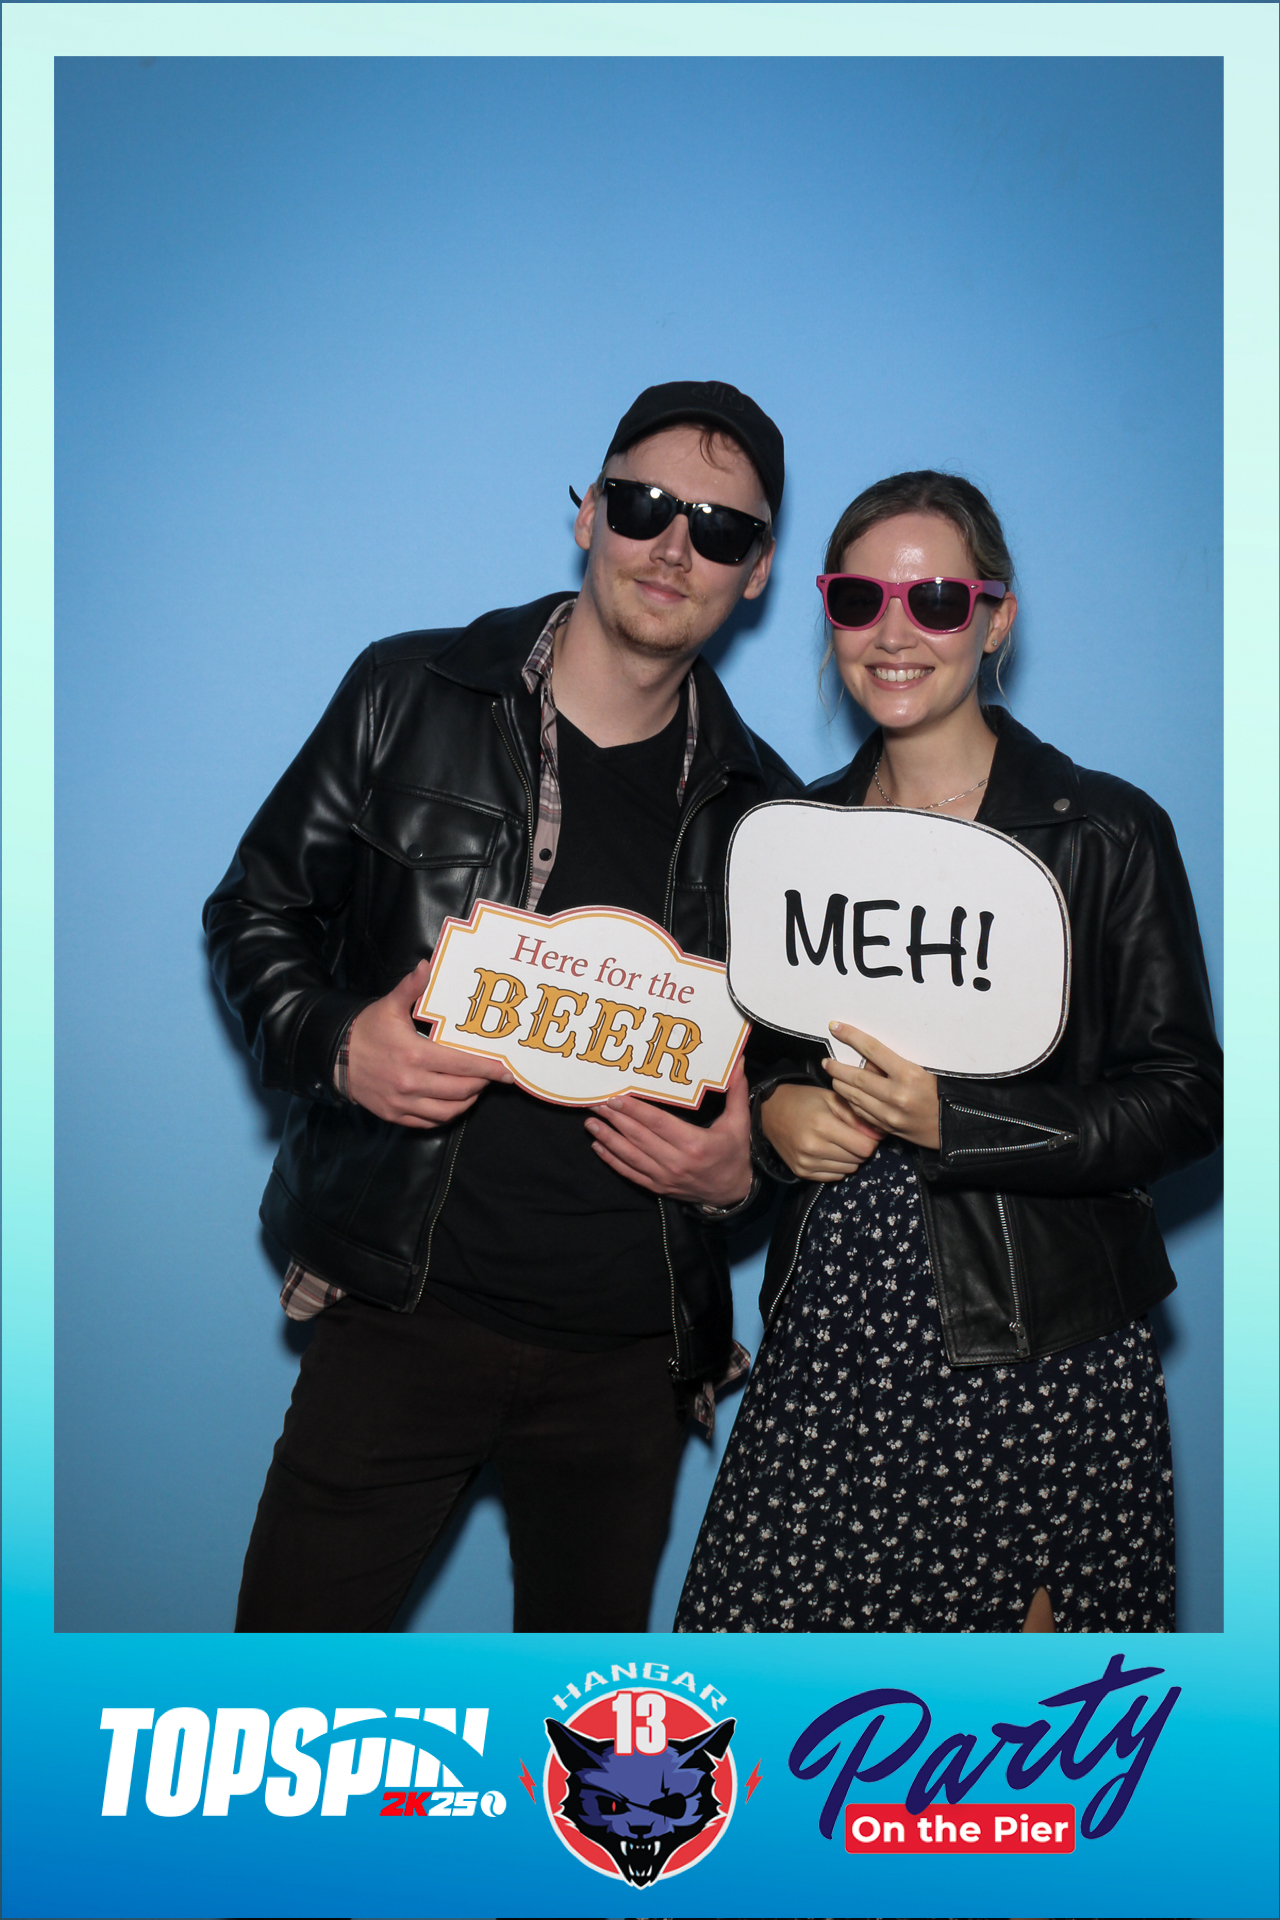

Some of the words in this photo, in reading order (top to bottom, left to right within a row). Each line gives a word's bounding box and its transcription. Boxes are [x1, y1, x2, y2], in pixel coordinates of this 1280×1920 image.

[509, 933, 590, 978] Here
[594, 956, 642, 992] for
[647, 971, 696, 1005] the
[784, 889, 995, 992] MEH!
[455, 967, 704, 1086] BEER
